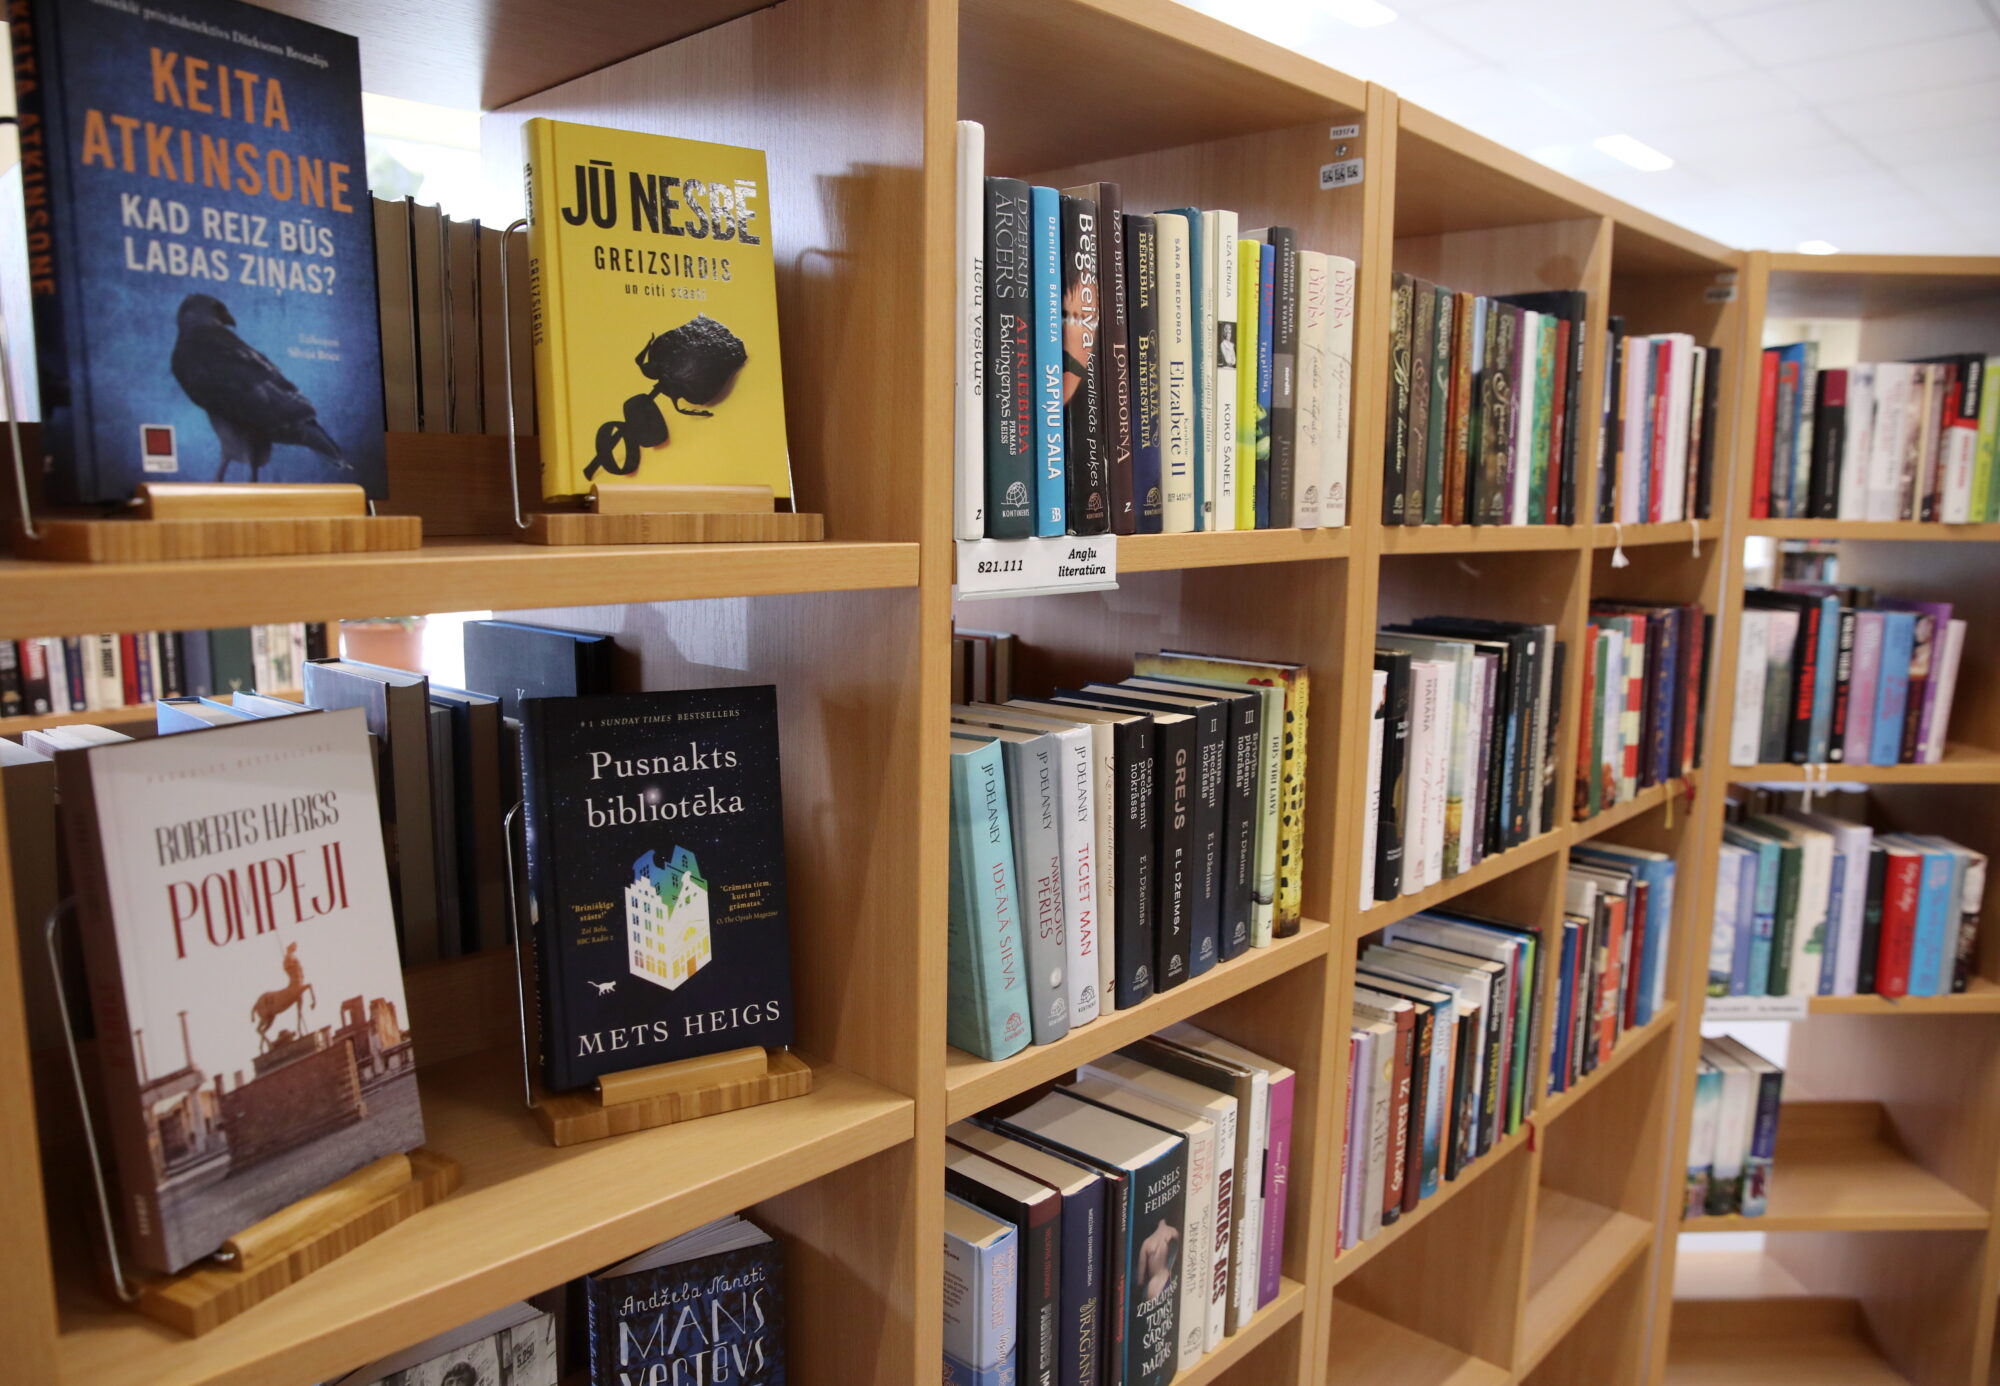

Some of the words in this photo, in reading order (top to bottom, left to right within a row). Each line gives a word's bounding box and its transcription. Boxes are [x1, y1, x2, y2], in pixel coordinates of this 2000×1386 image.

[150, 47, 289, 131] KEITA
[82, 109, 353, 214] ATKINSONE
[19, 113, 55, 295] ATKINSONE
[121, 193, 189, 235] KAD
[203, 208, 268, 248] REIZ
[280, 219, 335, 257] BŪS
[561, 160, 617, 229] JŪ
[629, 171, 760, 246] NESBĒ
[124, 237, 229, 281] LABAS
[239, 252, 336, 296] ZIŅAS?
[594, 246, 732, 282] GREIZSIRDIS
[995, 191, 1017, 299] ĀRČERS
[625, 284, 638, 295] un
[644, 284, 665, 298] citi
[1075, 214, 1096, 348] Begšeiva
[1041, 364, 1061, 427] SAPŅU
[1086, 352, 1098, 434] karaliskās
[1112, 342, 1131, 464] LONGBORNA
[1169, 361, 1184, 456] Elizabete
[1000, 421, 1008, 444] REISS
[1223, 403, 1231, 440] KOKO
[1046, 433, 1062, 480] SALA
[1085, 438, 1101, 487] puķes
[1171, 462, 1186, 477] II
[1223, 446, 1233, 497] ŠANELE
[977, 559, 1023, 574] 821.111
[1058, 564, 1106, 578] literatūra
[1068, 547, 1097, 561] Angļu
[600, 717, 640, 728] SUNDAY
[643, 714, 672, 724] TIMES
[677, 709, 741, 721] BESTSELLERS
[589, 741, 738, 781] Pusnakts
[981, 763, 994, 777] JP
[1037, 751, 1049, 764] JP
[1074, 746, 1087, 759] JP
[1208, 743, 1218, 808] piecdesmit
[1216, 740, 1224, 785] Tumsa
[1243, 734, 1253, 797] piecdesmit
[585, 786, 745, 829] bibliotēka
[984, 781, 1000, 845] DELANEY
[1039, 767, 1052, 830] DELANEY
[1076, 762, 1089, 823] DELANEY
[1130, 763, 1139, 820] nokrāsas
[1139, 761, 1147, 829] piecdesmit
[1174, 748, 1187, 830] GREJS
[154, 807, 259, 867] ROBERTS
[262, 790, 339, 842] HARISS
[1175, 848, 1182, 858] E
[1207, 832, 1215, 840] E
[1207, 842, 1214, 850] L
[1240, 830, 1248, 838] L
[1077, 842, 1090, 902] TICIET
[1139, 866, 1146, 874] L
[1174, 861, 1182, 870] L
[166, 841, 349, 960] POMPEJI
[991, 862, 1011, 932] IDEĀLĀ
[1050, 855, 1064, 946] MIKIMOTO
[1139, 877, 1147, 926] Džeimsa
[1172, 872, 1182, 935] DŽEIMSA
[1079, 911, 1092, 957] MAN
[999, 936, 1016, 990] SIEVA
[577, 1020, 669, 1057] METS
[684, 1000, 780, 1038] HEIGS
[1144, 1180, 1180, 1214] FEIBERS
[1148, 1166, 1180, 1197] MIŠELS
[1215, 1168, 1233, 1253] ADATAS
[619, 1282, 702, 1317] Andžela
[707, 1267, 766, 1295] Naneti
[1212, 1257, 1227, 1305] ACS
[619, 1288, 765, 1366] MANS
